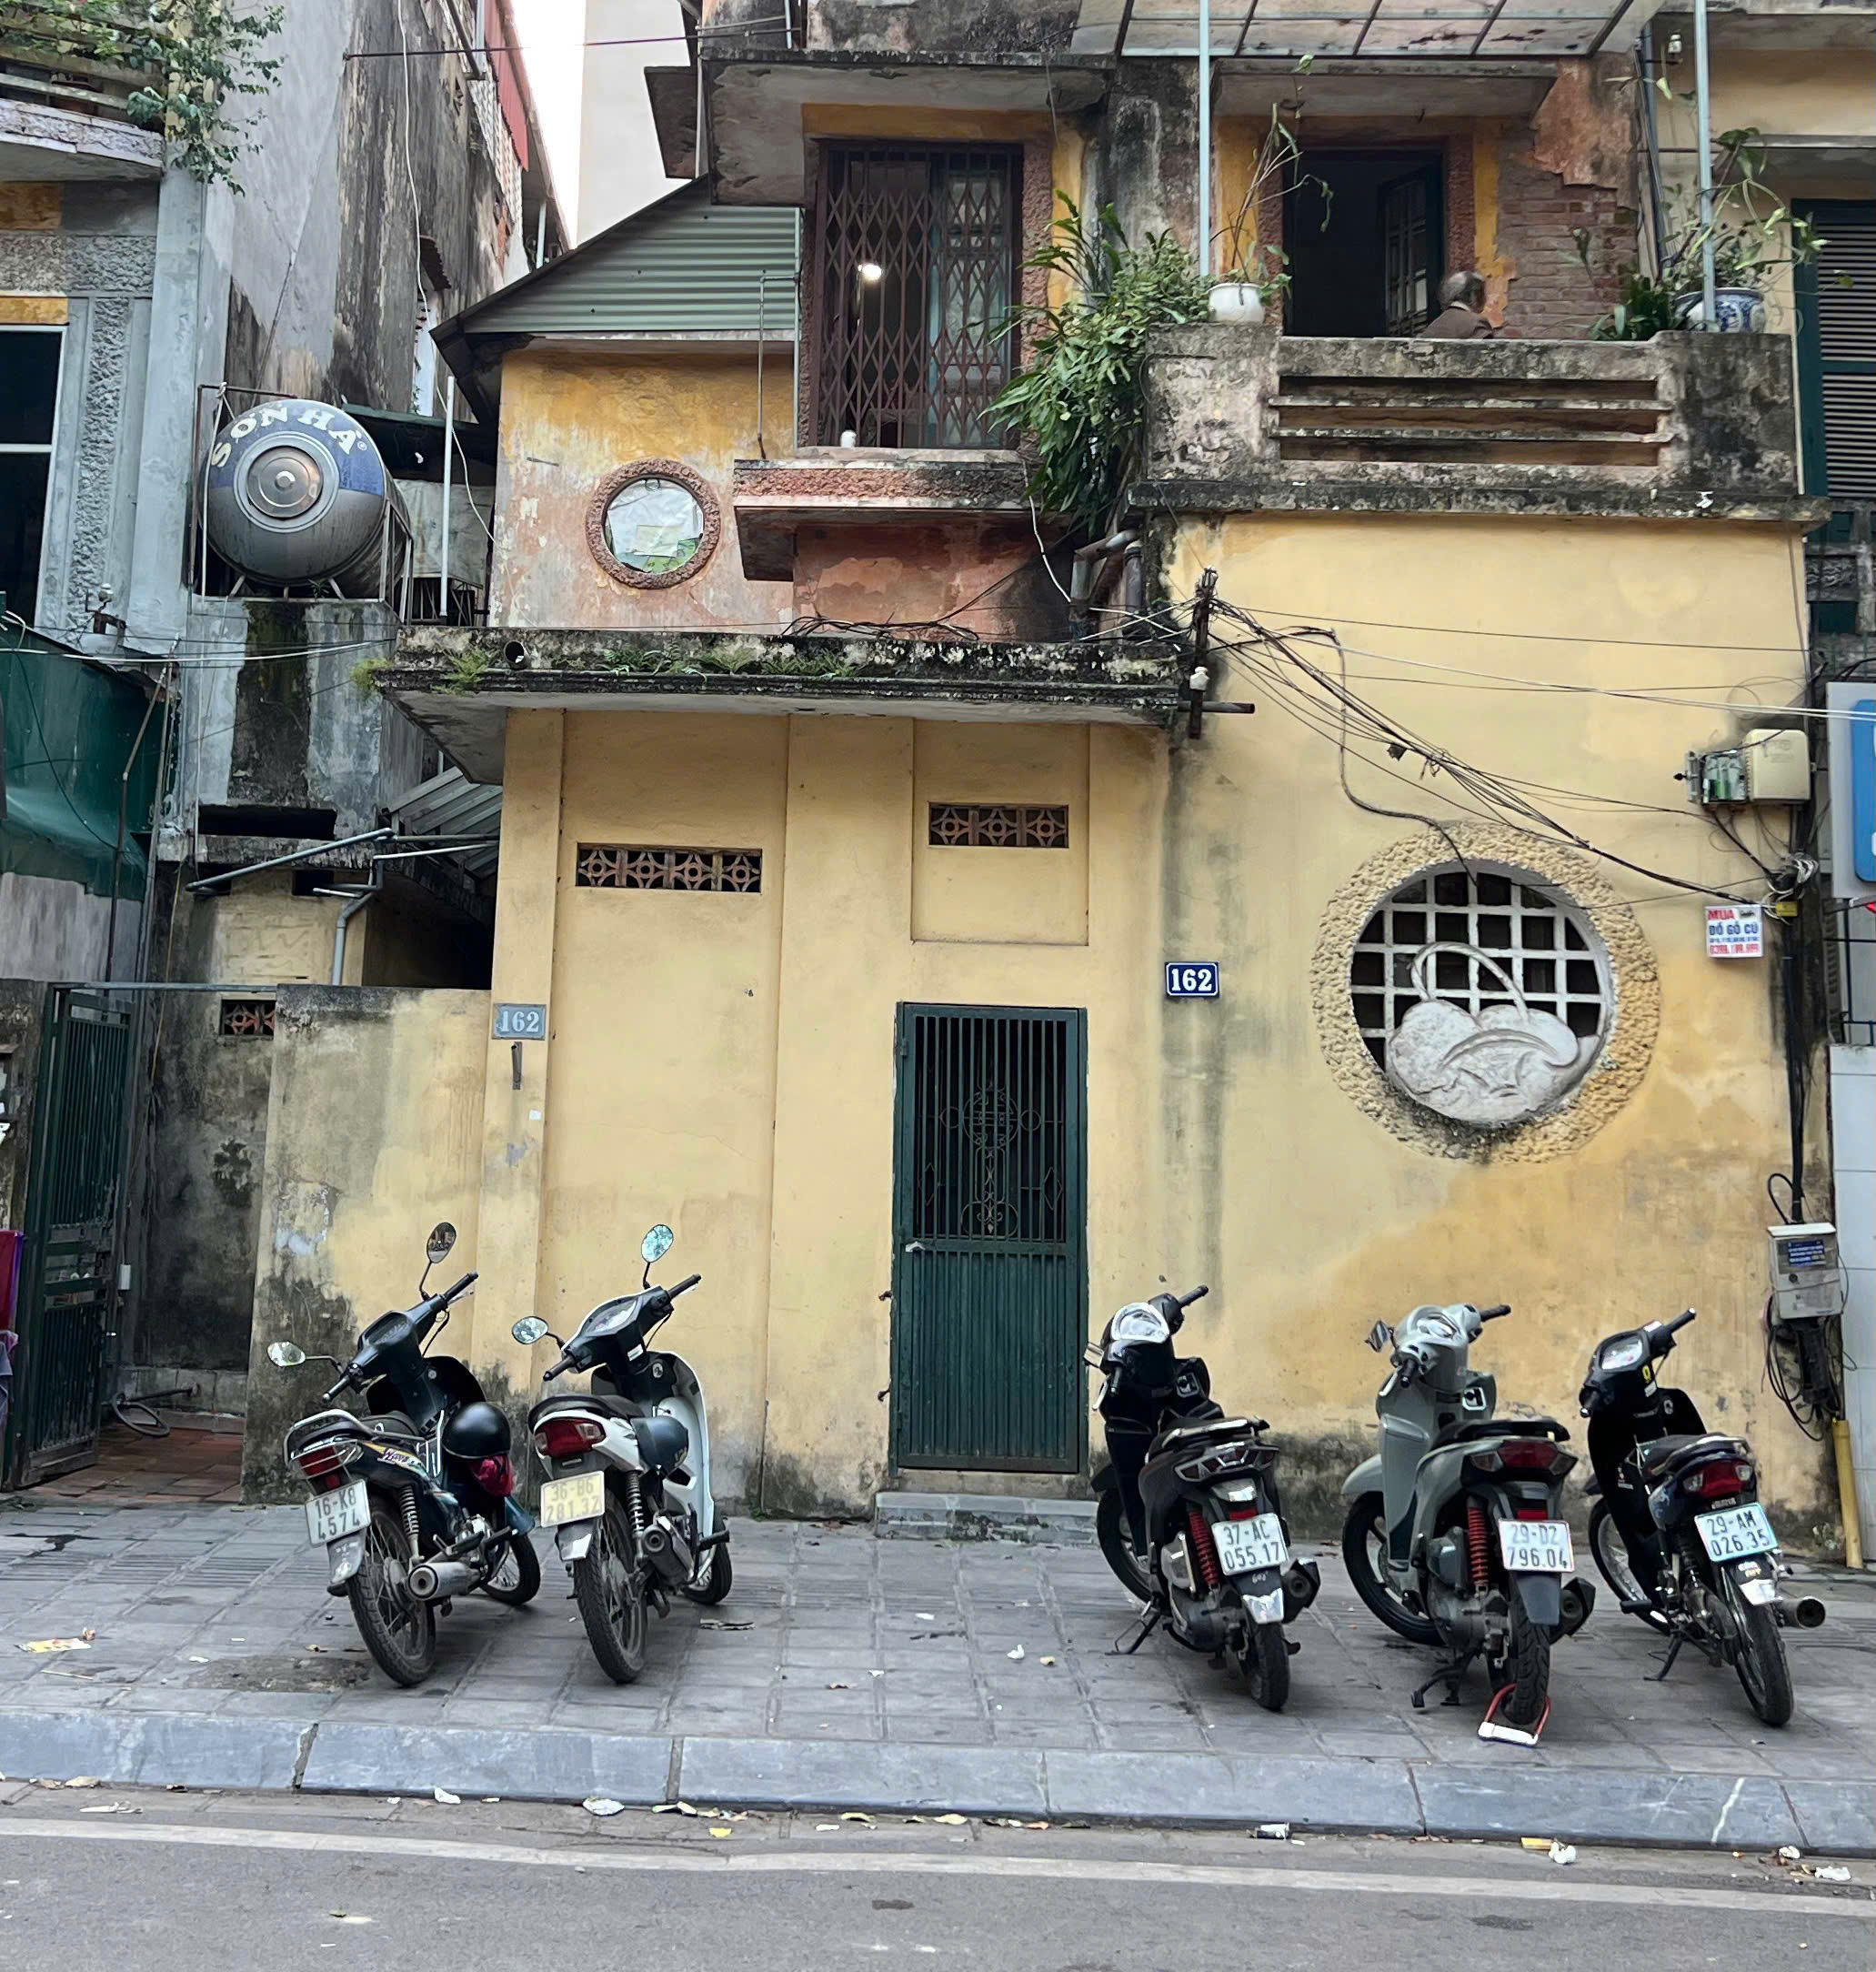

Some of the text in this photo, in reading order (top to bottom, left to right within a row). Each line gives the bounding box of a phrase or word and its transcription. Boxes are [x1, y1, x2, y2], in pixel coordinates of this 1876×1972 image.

[1708, 909, 1735, 921] MUA
[1171, 968, 1212, 991] 162
[500, 1011, 539, 1032] 162
[315, 1487, 356, 1519] 16-K8
[317, 1508, 360, 1540] 4574
[1223, 1519, 1270, 1545] 37-AC
[1510, 1524, 1559, 1545] 29-D2
[1706, 1510, 1757, 1536] 29-AM
[1710, 1528, 1771, 1556] 026.35
[1224, 1541, 1279, 1570] 055.17
[1507, 1546, 1568, 1569] 796.04
